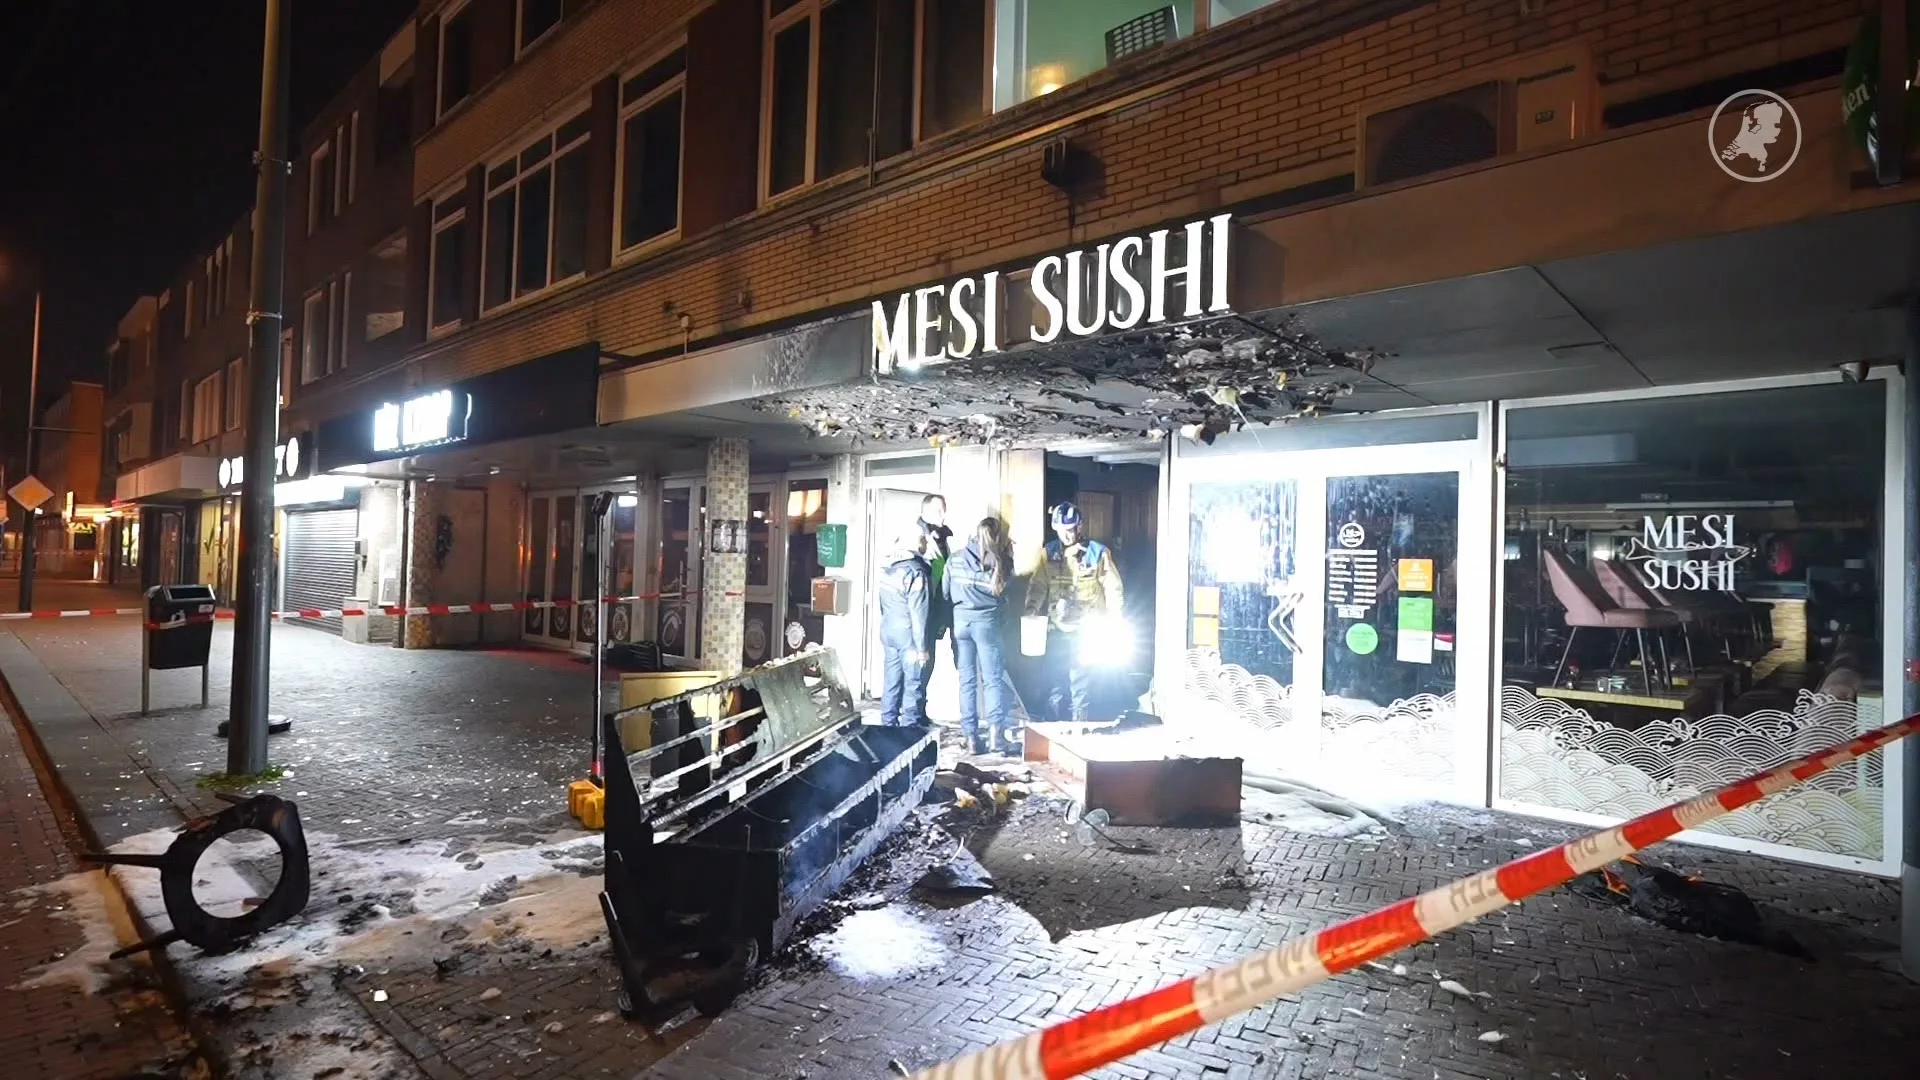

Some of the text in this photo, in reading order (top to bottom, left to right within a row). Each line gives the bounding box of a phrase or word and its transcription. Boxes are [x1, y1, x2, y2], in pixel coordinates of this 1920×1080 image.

[871, 212, 1233, 375] MESI SUSHI
[1642, 514, 1736, 550] MESI
[1642, 559, 1736, 592] SUSHI
